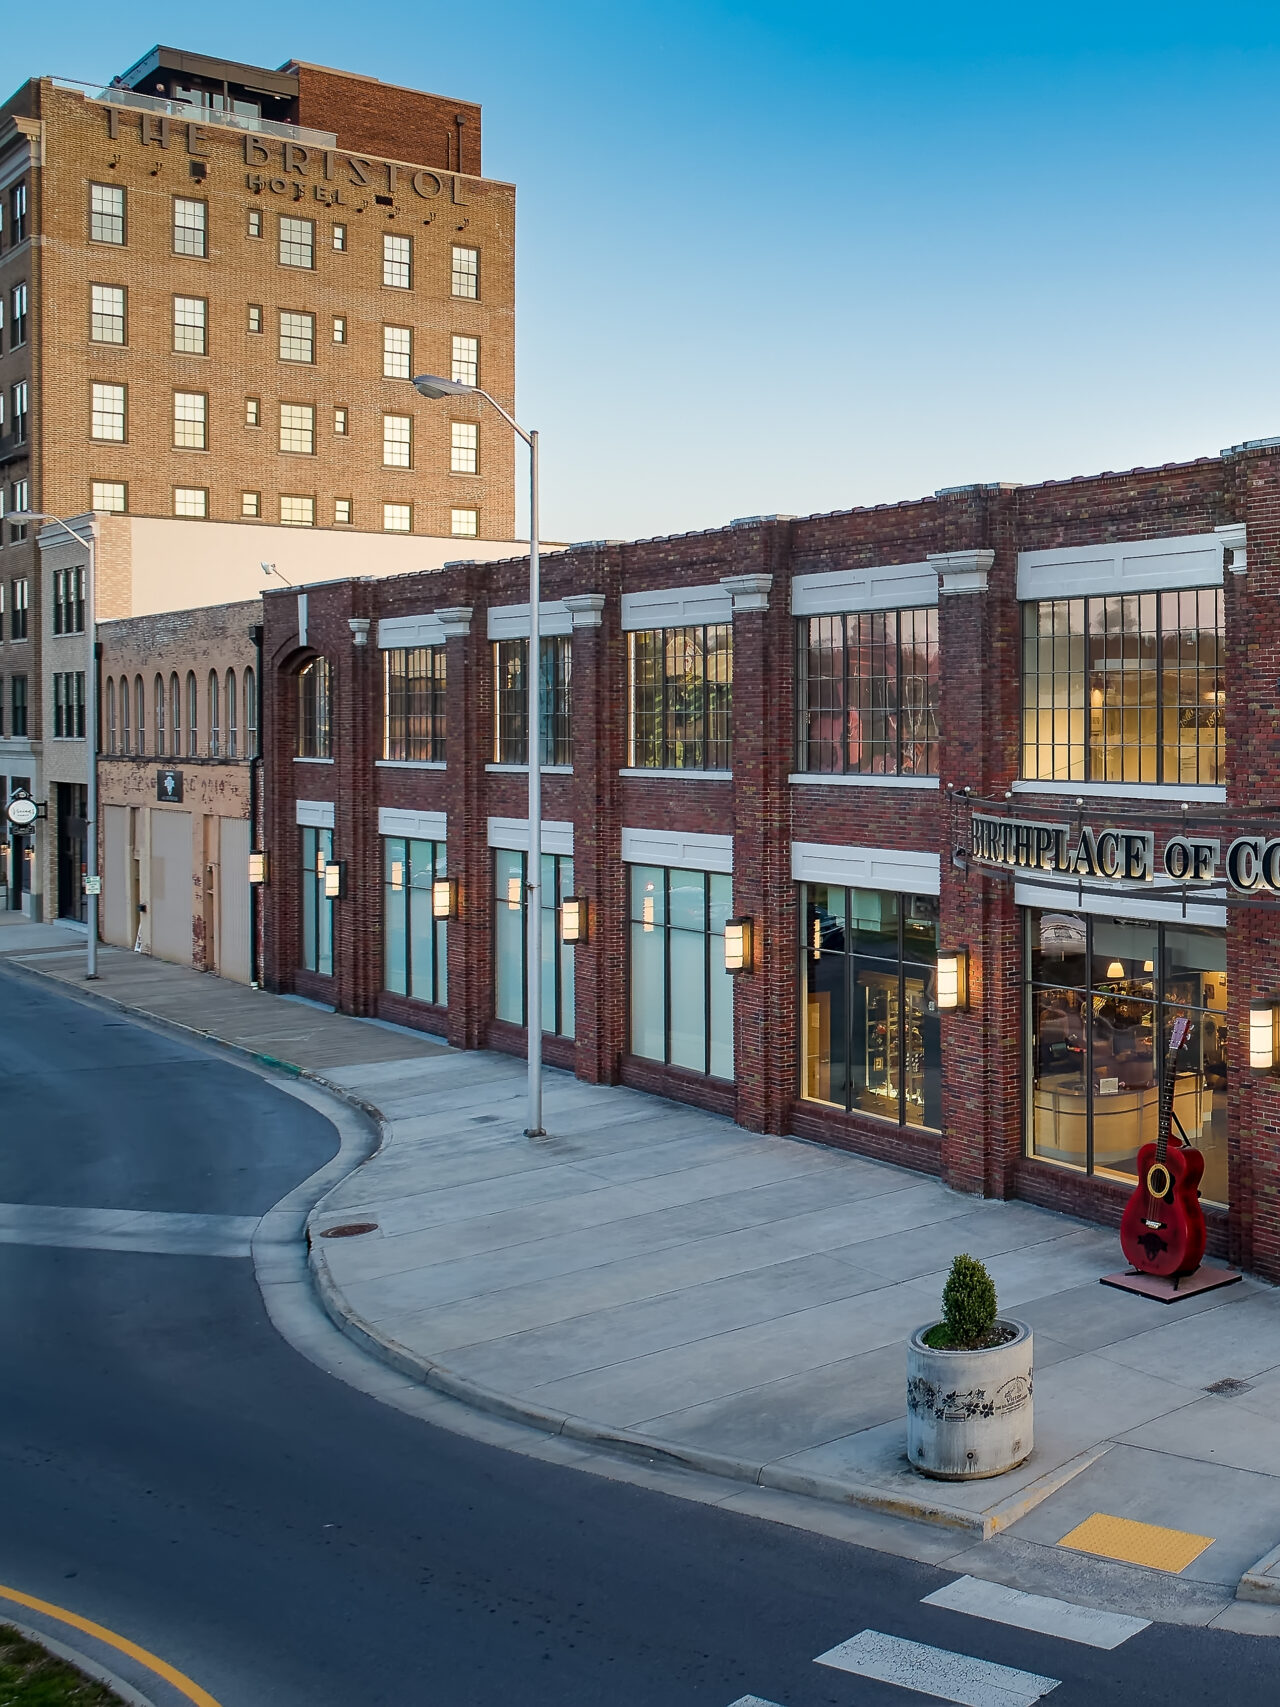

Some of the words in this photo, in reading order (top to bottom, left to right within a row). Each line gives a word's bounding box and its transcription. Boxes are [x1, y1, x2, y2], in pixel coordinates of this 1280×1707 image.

[102, 106, 211, 158] THE
[245, 133, 469, 207] BRISTOL
[247, 173, 347, 206] HOTEL
[971, 816, 1150, 882] BIRTHPLACE
[1164, 841, 1213, 881] OF
